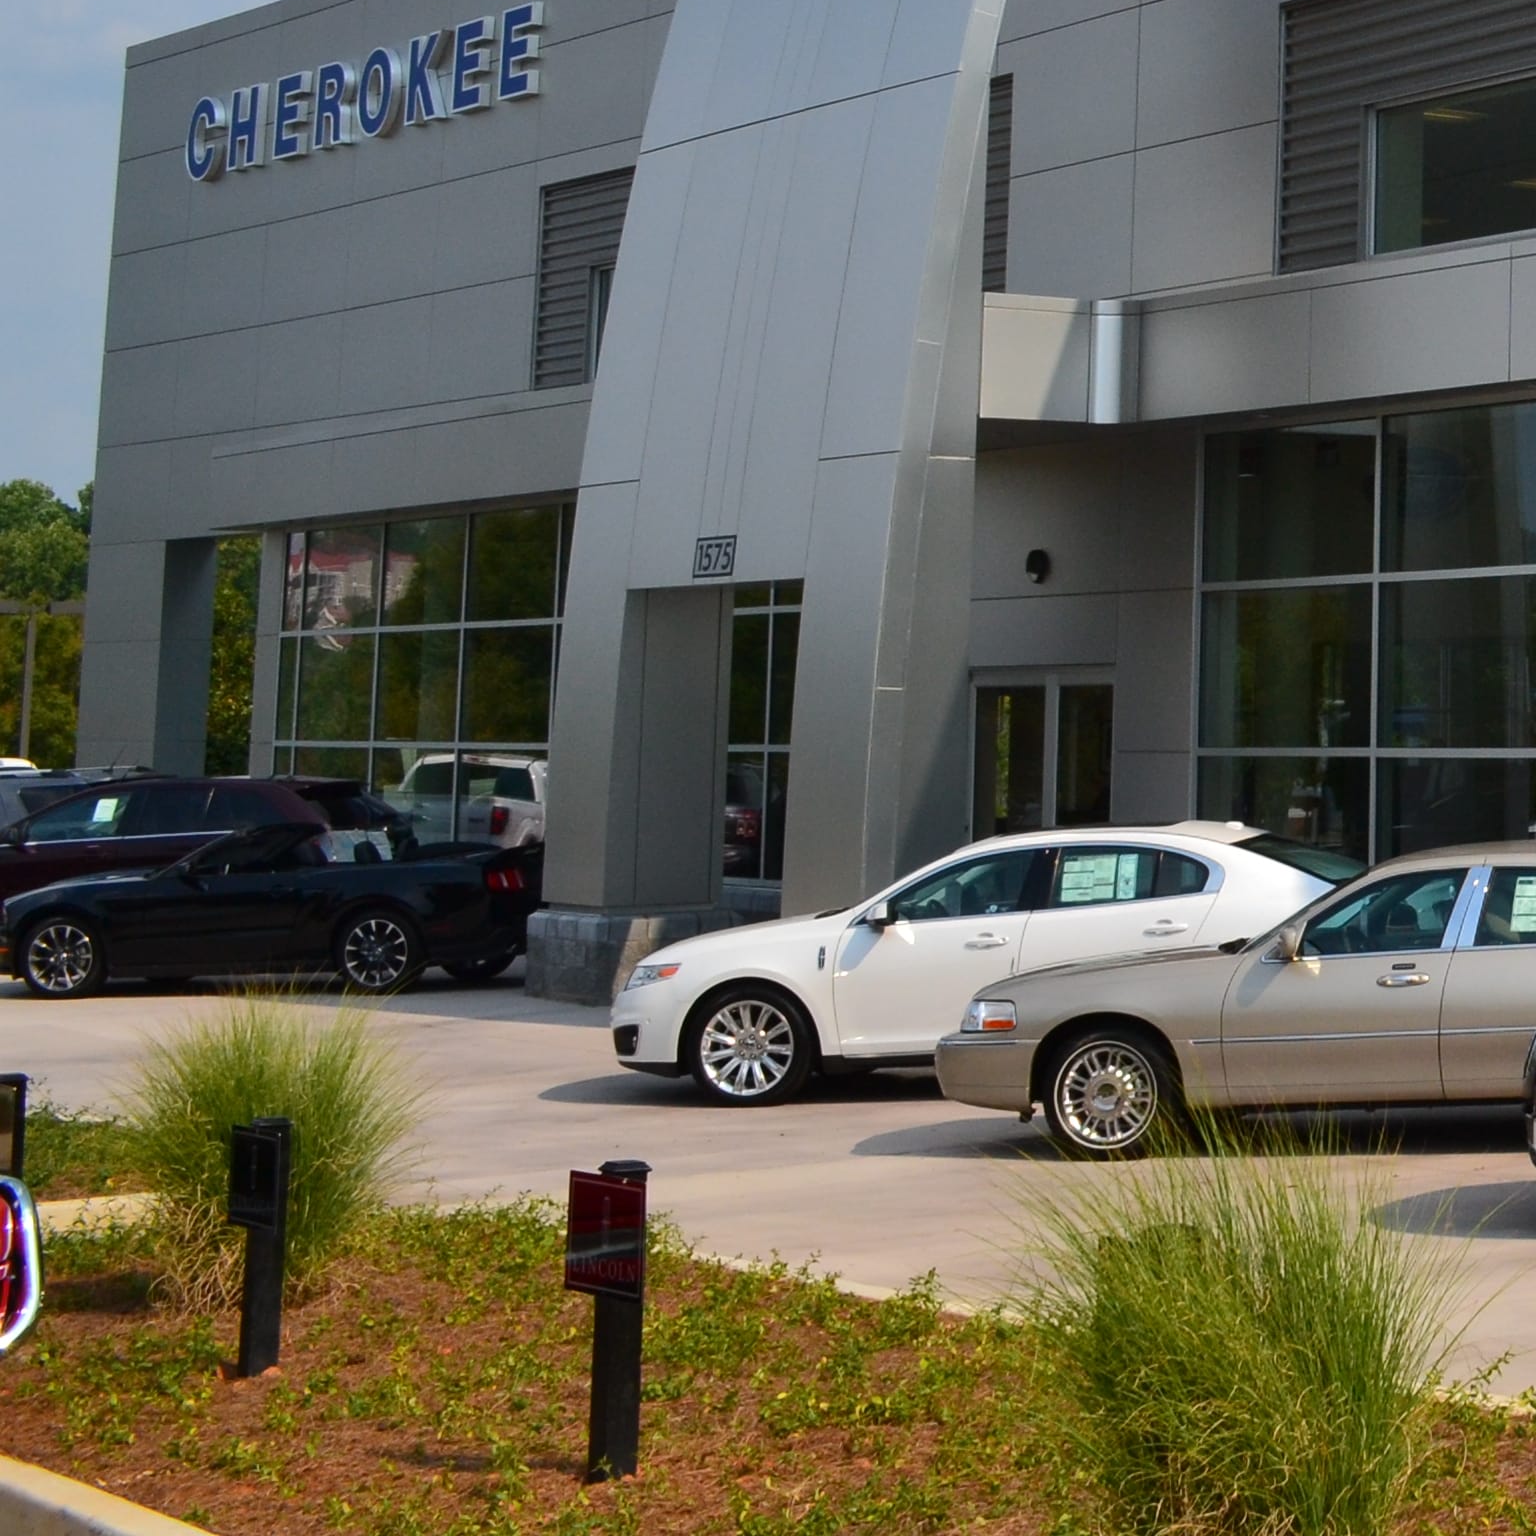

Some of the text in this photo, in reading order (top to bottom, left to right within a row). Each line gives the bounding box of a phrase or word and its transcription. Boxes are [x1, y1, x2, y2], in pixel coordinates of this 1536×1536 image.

[185, 1, 544, 182] CHEROKEE
[698, 541, 733, 572] 1575
[571, 1255, 636, 1283] LINCOLN
